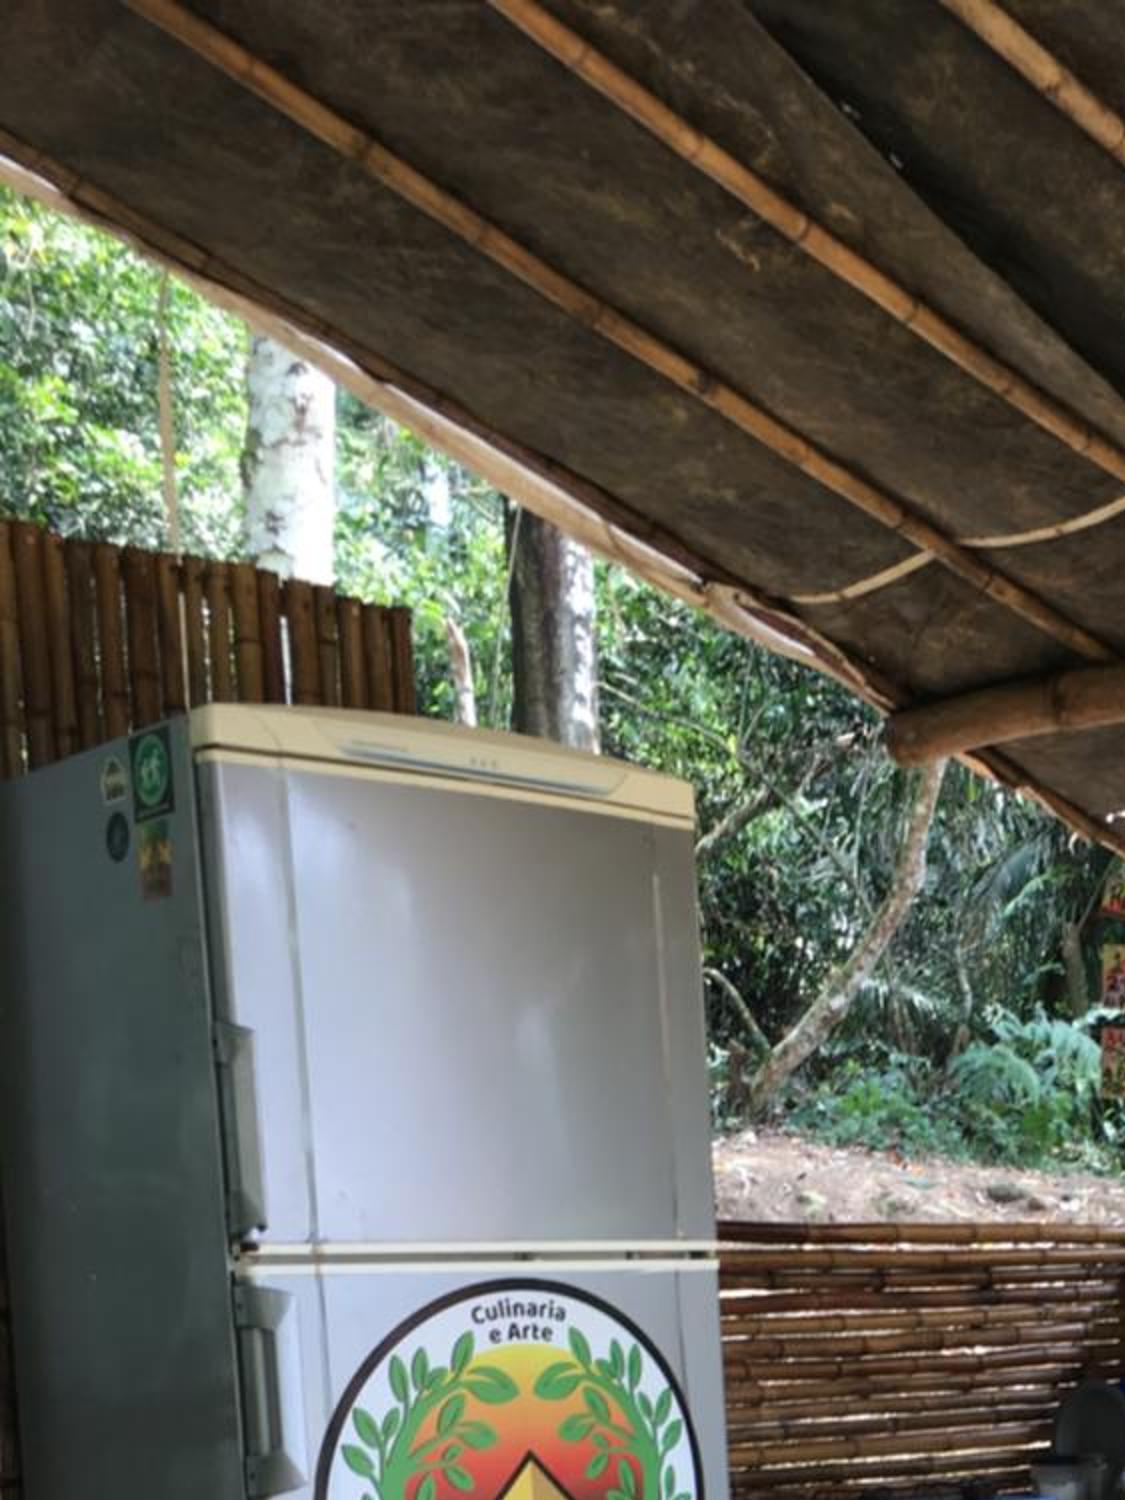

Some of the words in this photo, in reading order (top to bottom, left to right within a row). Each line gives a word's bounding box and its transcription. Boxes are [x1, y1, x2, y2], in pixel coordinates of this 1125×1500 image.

[471, 1298, 567, 1324] Culinaria
[489, 1328, 502, 1344] e
[508, 1322, 554, 1343] Arte
